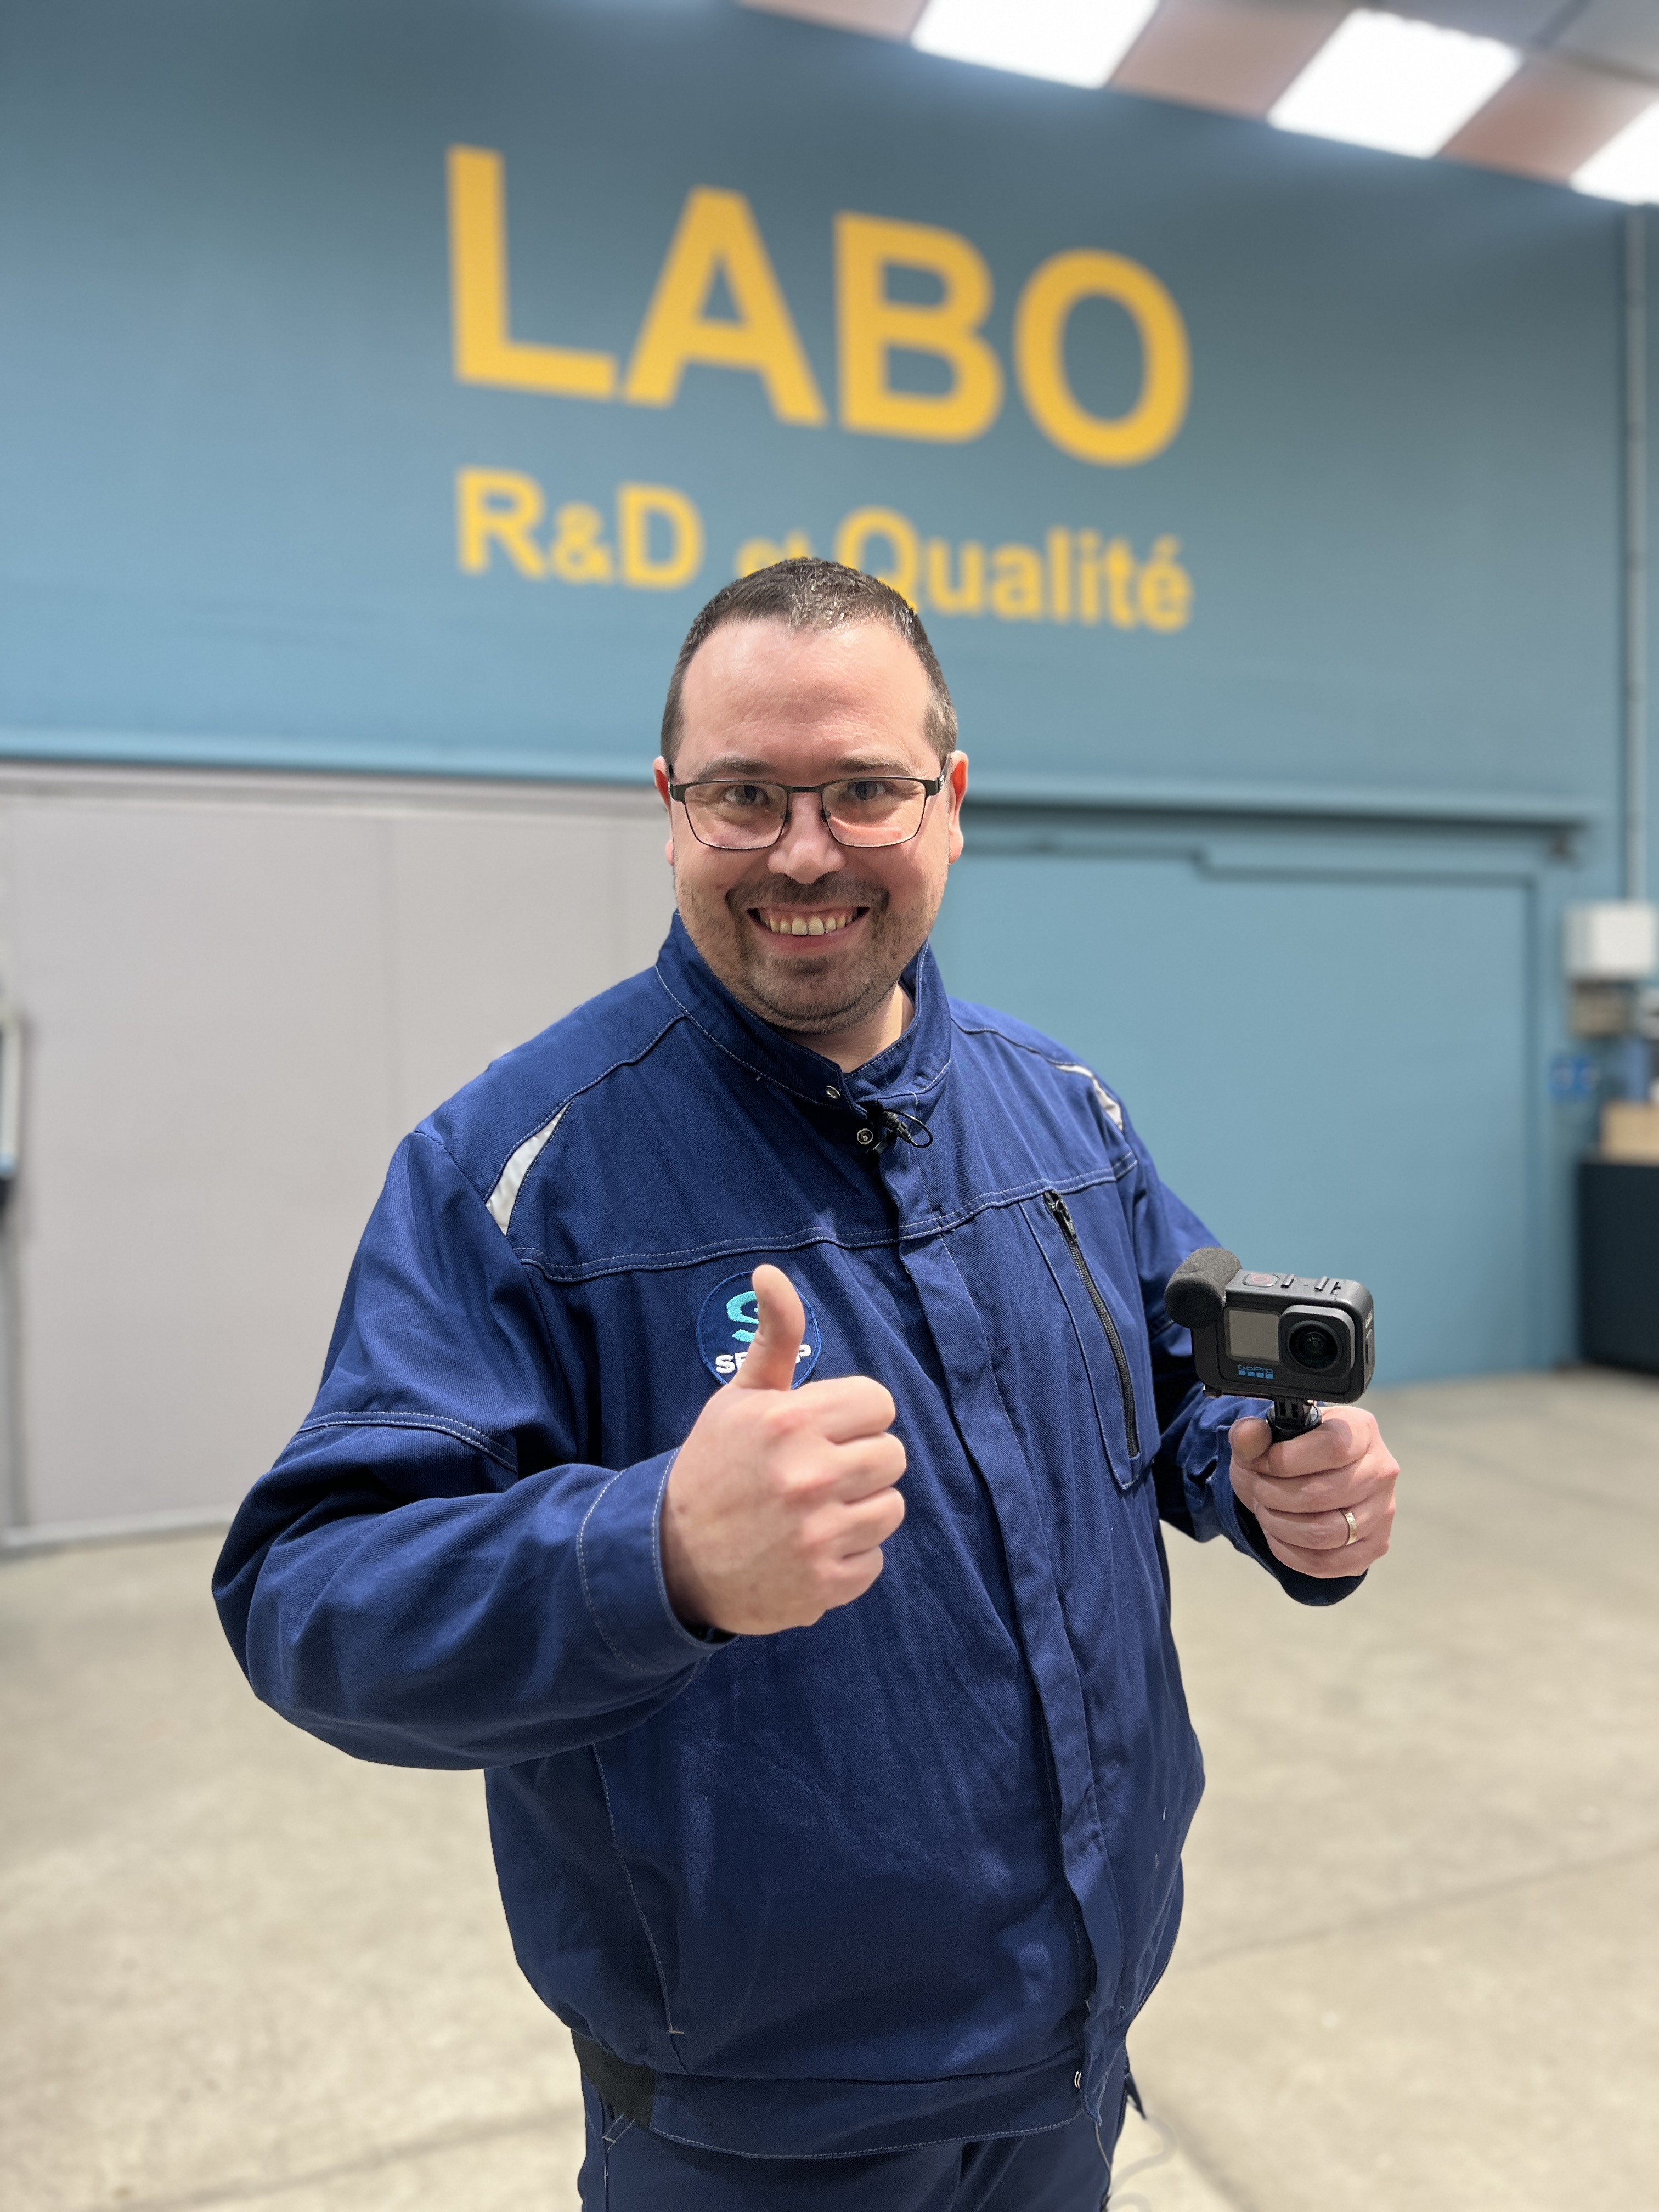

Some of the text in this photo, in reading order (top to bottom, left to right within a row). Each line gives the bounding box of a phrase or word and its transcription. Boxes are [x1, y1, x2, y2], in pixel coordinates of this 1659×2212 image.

[448, 145, 1191, 465] LABO
[458, 467, 703, 589] R&D
[835, 507, 1192, 631] Qualité
[1238, 1364, 1273, 1374] GoPro
